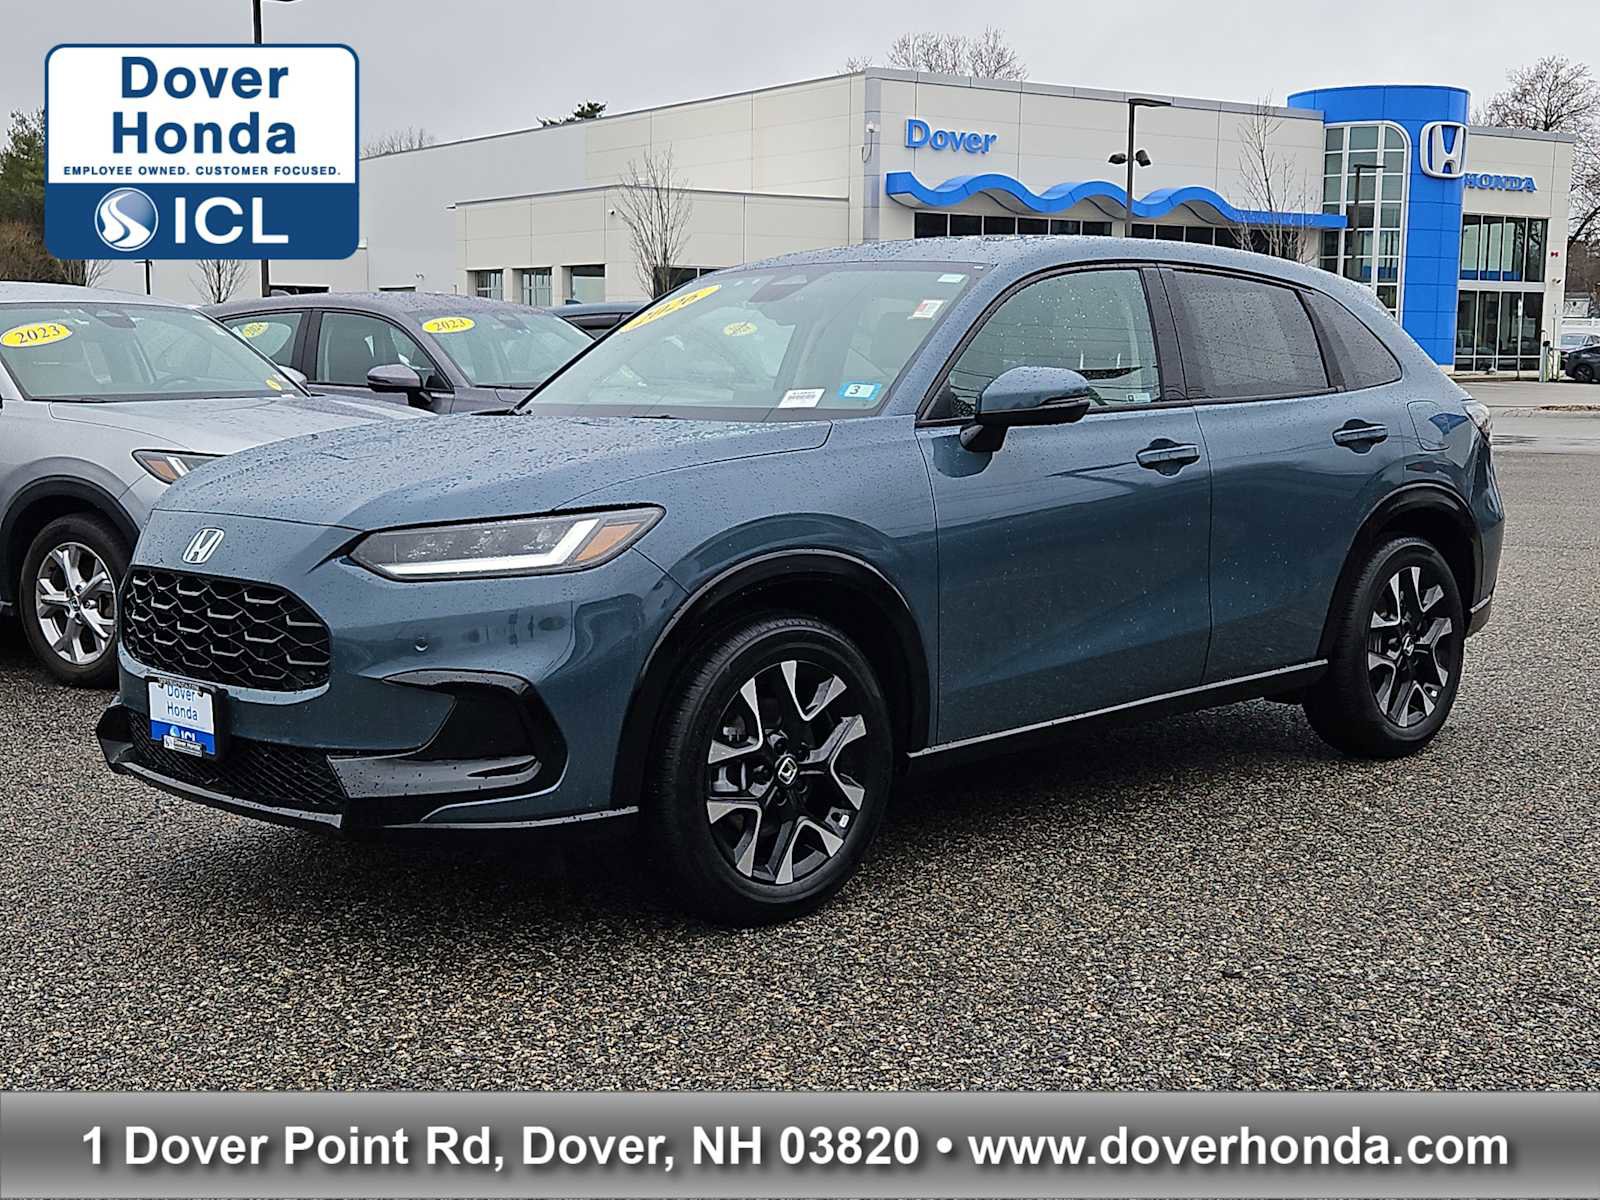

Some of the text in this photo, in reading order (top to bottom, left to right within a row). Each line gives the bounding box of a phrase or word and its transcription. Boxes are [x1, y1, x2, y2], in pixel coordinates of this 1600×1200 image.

[906, 119, 998, 155] Dover
[1464, 173, 1537, 193] HONDA
[433, 318, 465, 331] 2023
[15, 325, 60, 344] 2023
[849, 385, 861, 395] 3
[167, 684, 196, 702] Dover
[167, 701, 198, 721] Honda
